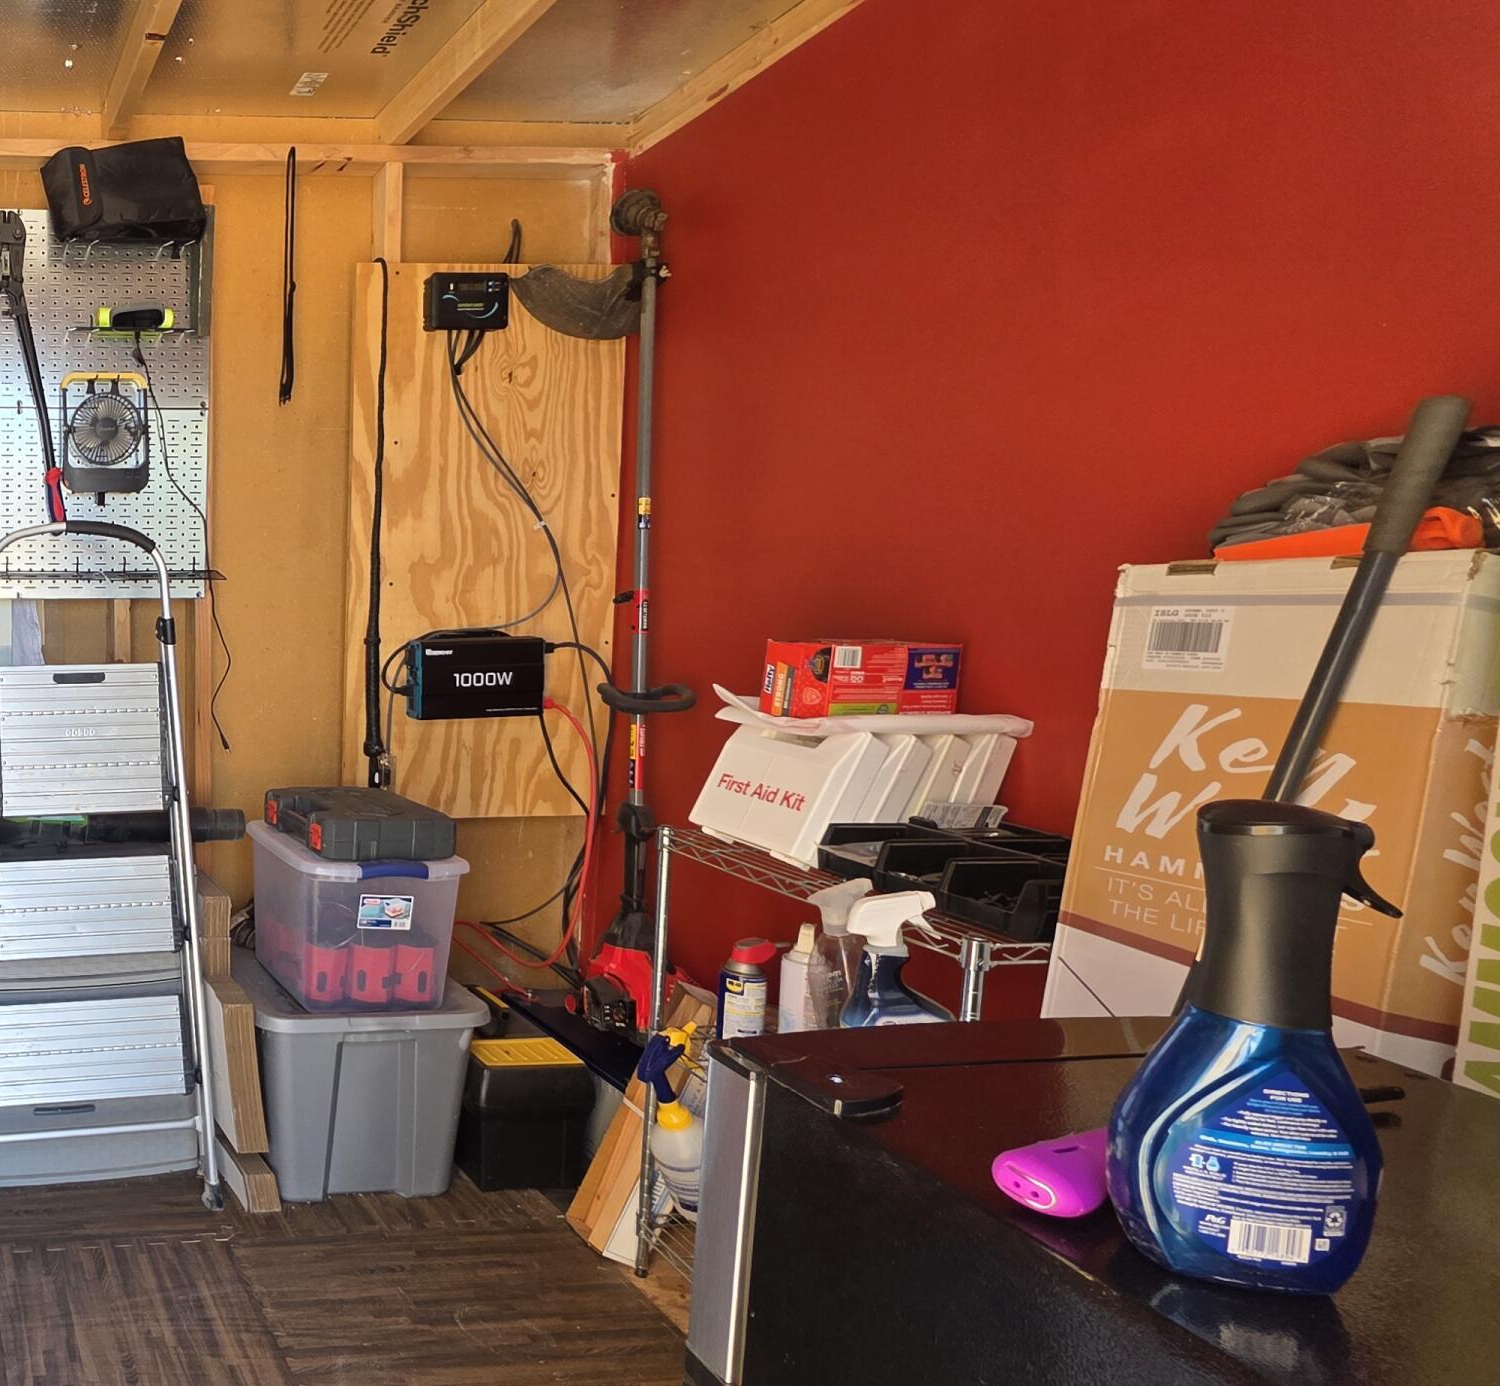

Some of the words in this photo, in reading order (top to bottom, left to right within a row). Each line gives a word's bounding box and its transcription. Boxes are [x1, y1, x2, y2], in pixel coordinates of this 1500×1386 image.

[452, 671, 513, 688] 1000W
[764, 664, 776, 693] Hefty
[717, 773, 751, 796] First
[750, 783, 780, 804] Aid
[779, 790, 805, 812] Kit
[1108, 876, 1154, 901] IT'S
[1109, 898, 1159, 926] THE
